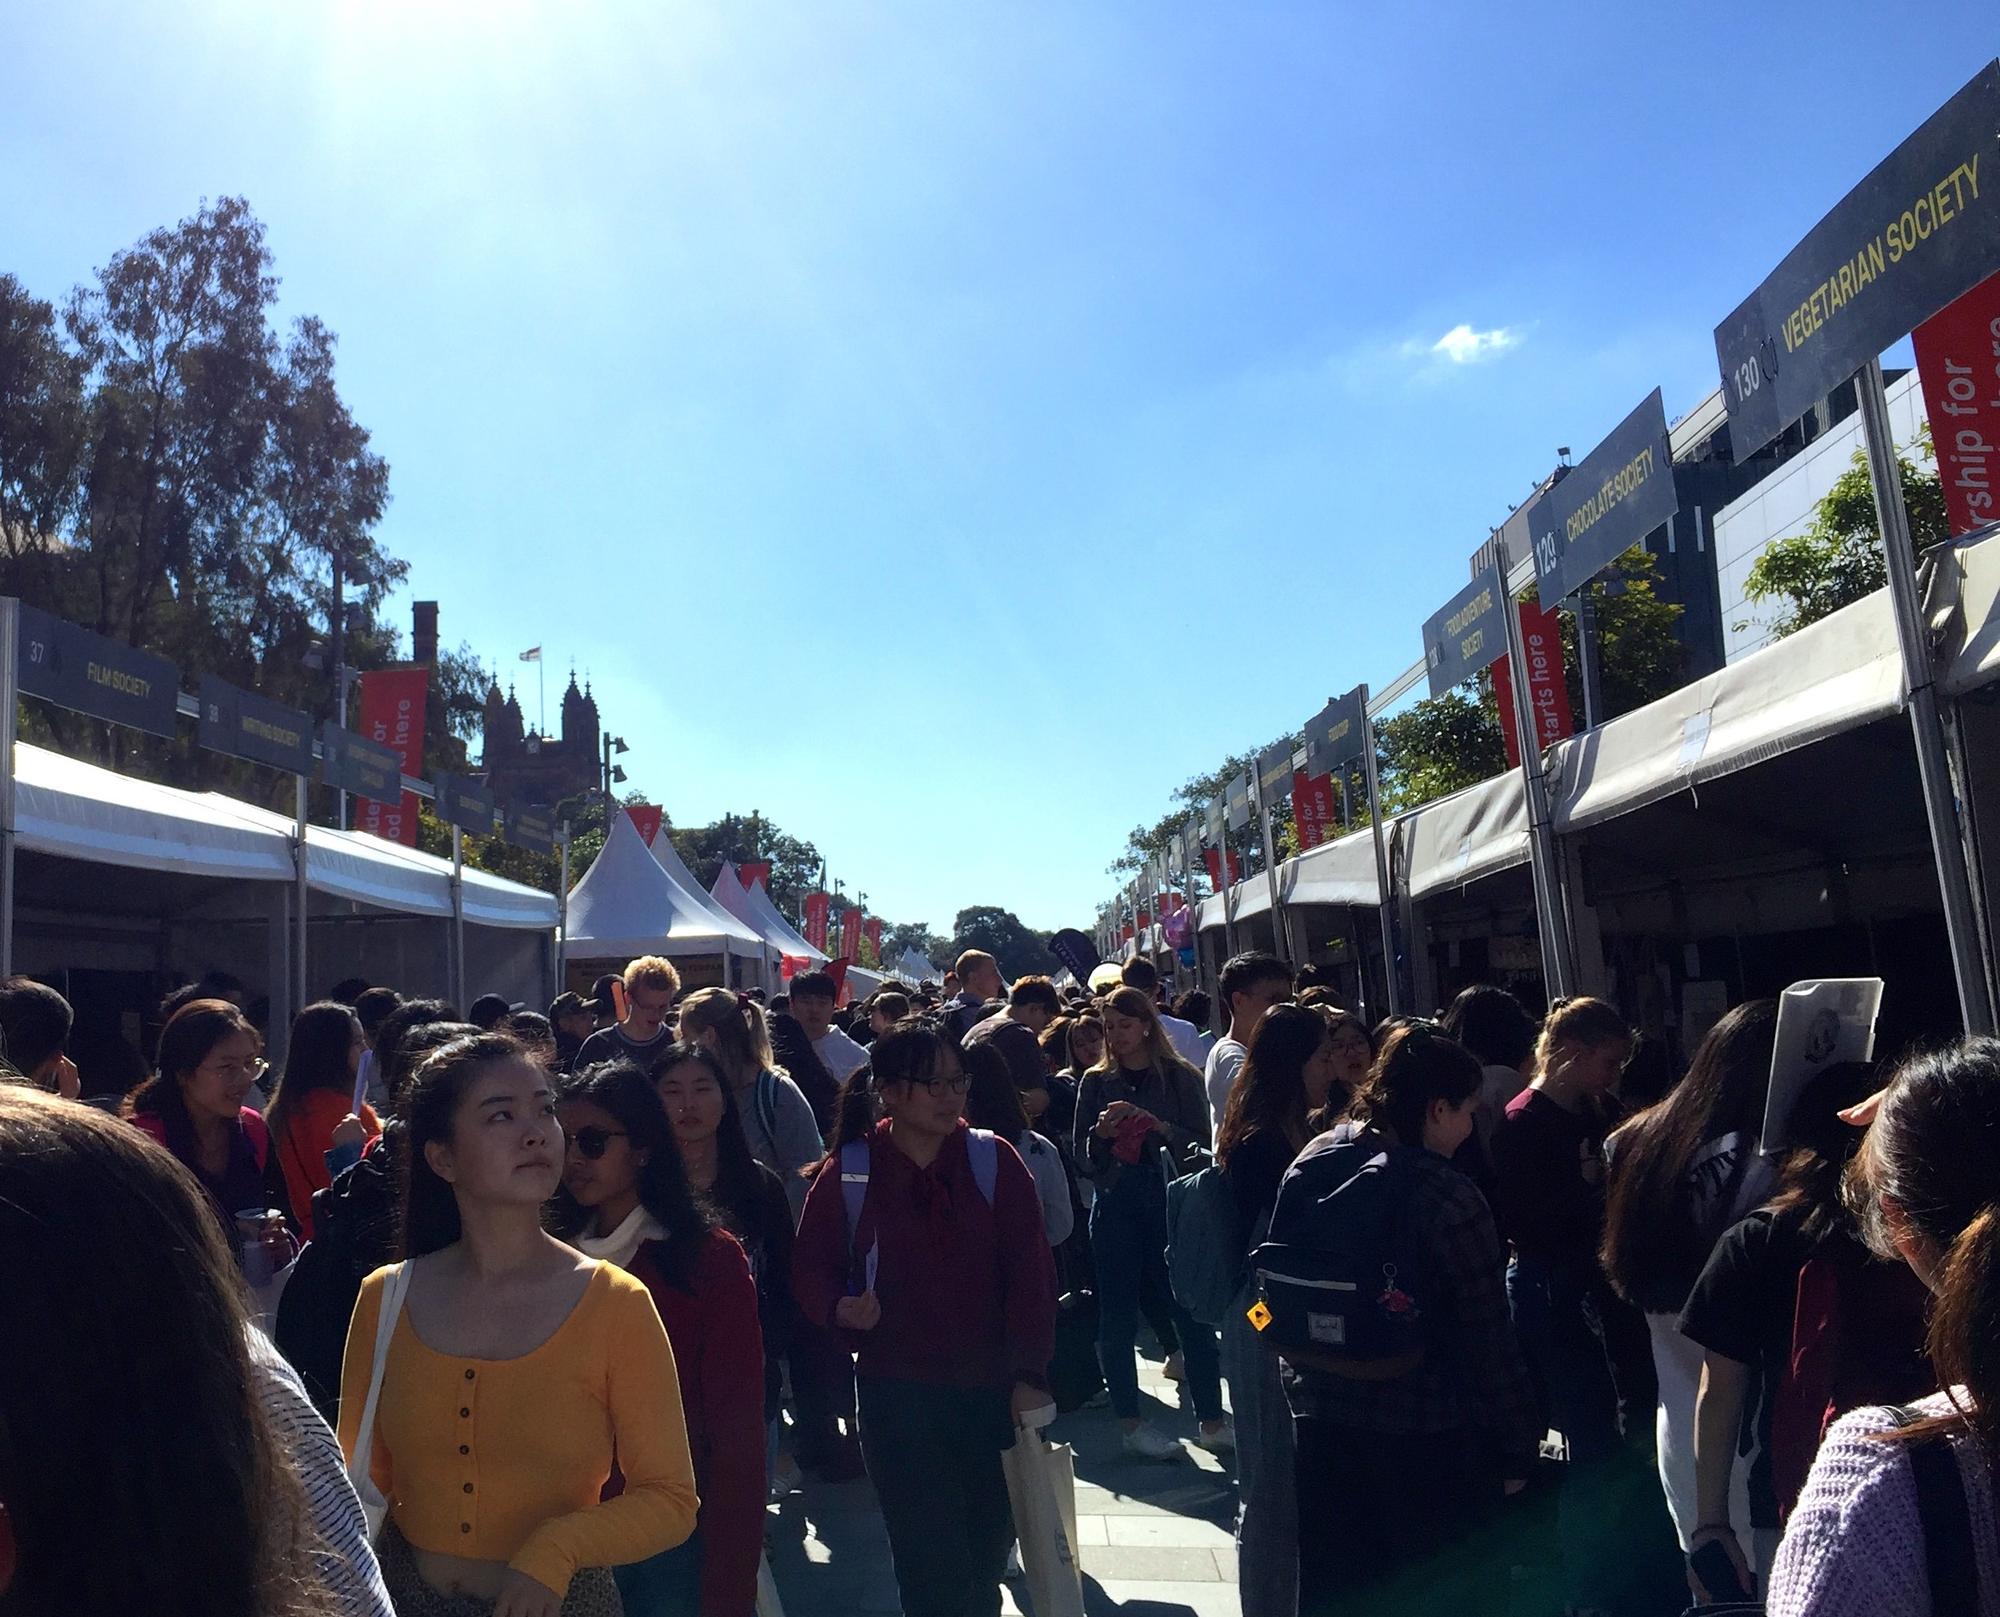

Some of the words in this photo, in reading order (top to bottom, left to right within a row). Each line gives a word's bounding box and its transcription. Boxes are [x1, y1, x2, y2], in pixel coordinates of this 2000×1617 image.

[1734, 355, 1760, 403] 130
[1782, 236, 1887, 354] VEGETARIAN
[1886, 153, 1980, 264] SOCIETY
[1941, 357, 1978, 417] for
[1950, 429, 1994, 530] rship
[1536, 531, 1557, 577] 129
[1566, 481, 1616, 543] CHOCOLATE
[1614, 445, 1655, 502] SOCIETY
[30, 640, 45, 664] 37
[87, 661, 112, 688] FILM
[112, 670, 153, 699] SOCIETY
[1528, 634, 1550, 682] here
[391, 700, 411, 744] here
[1538, 687, 1561, 743] tarts
